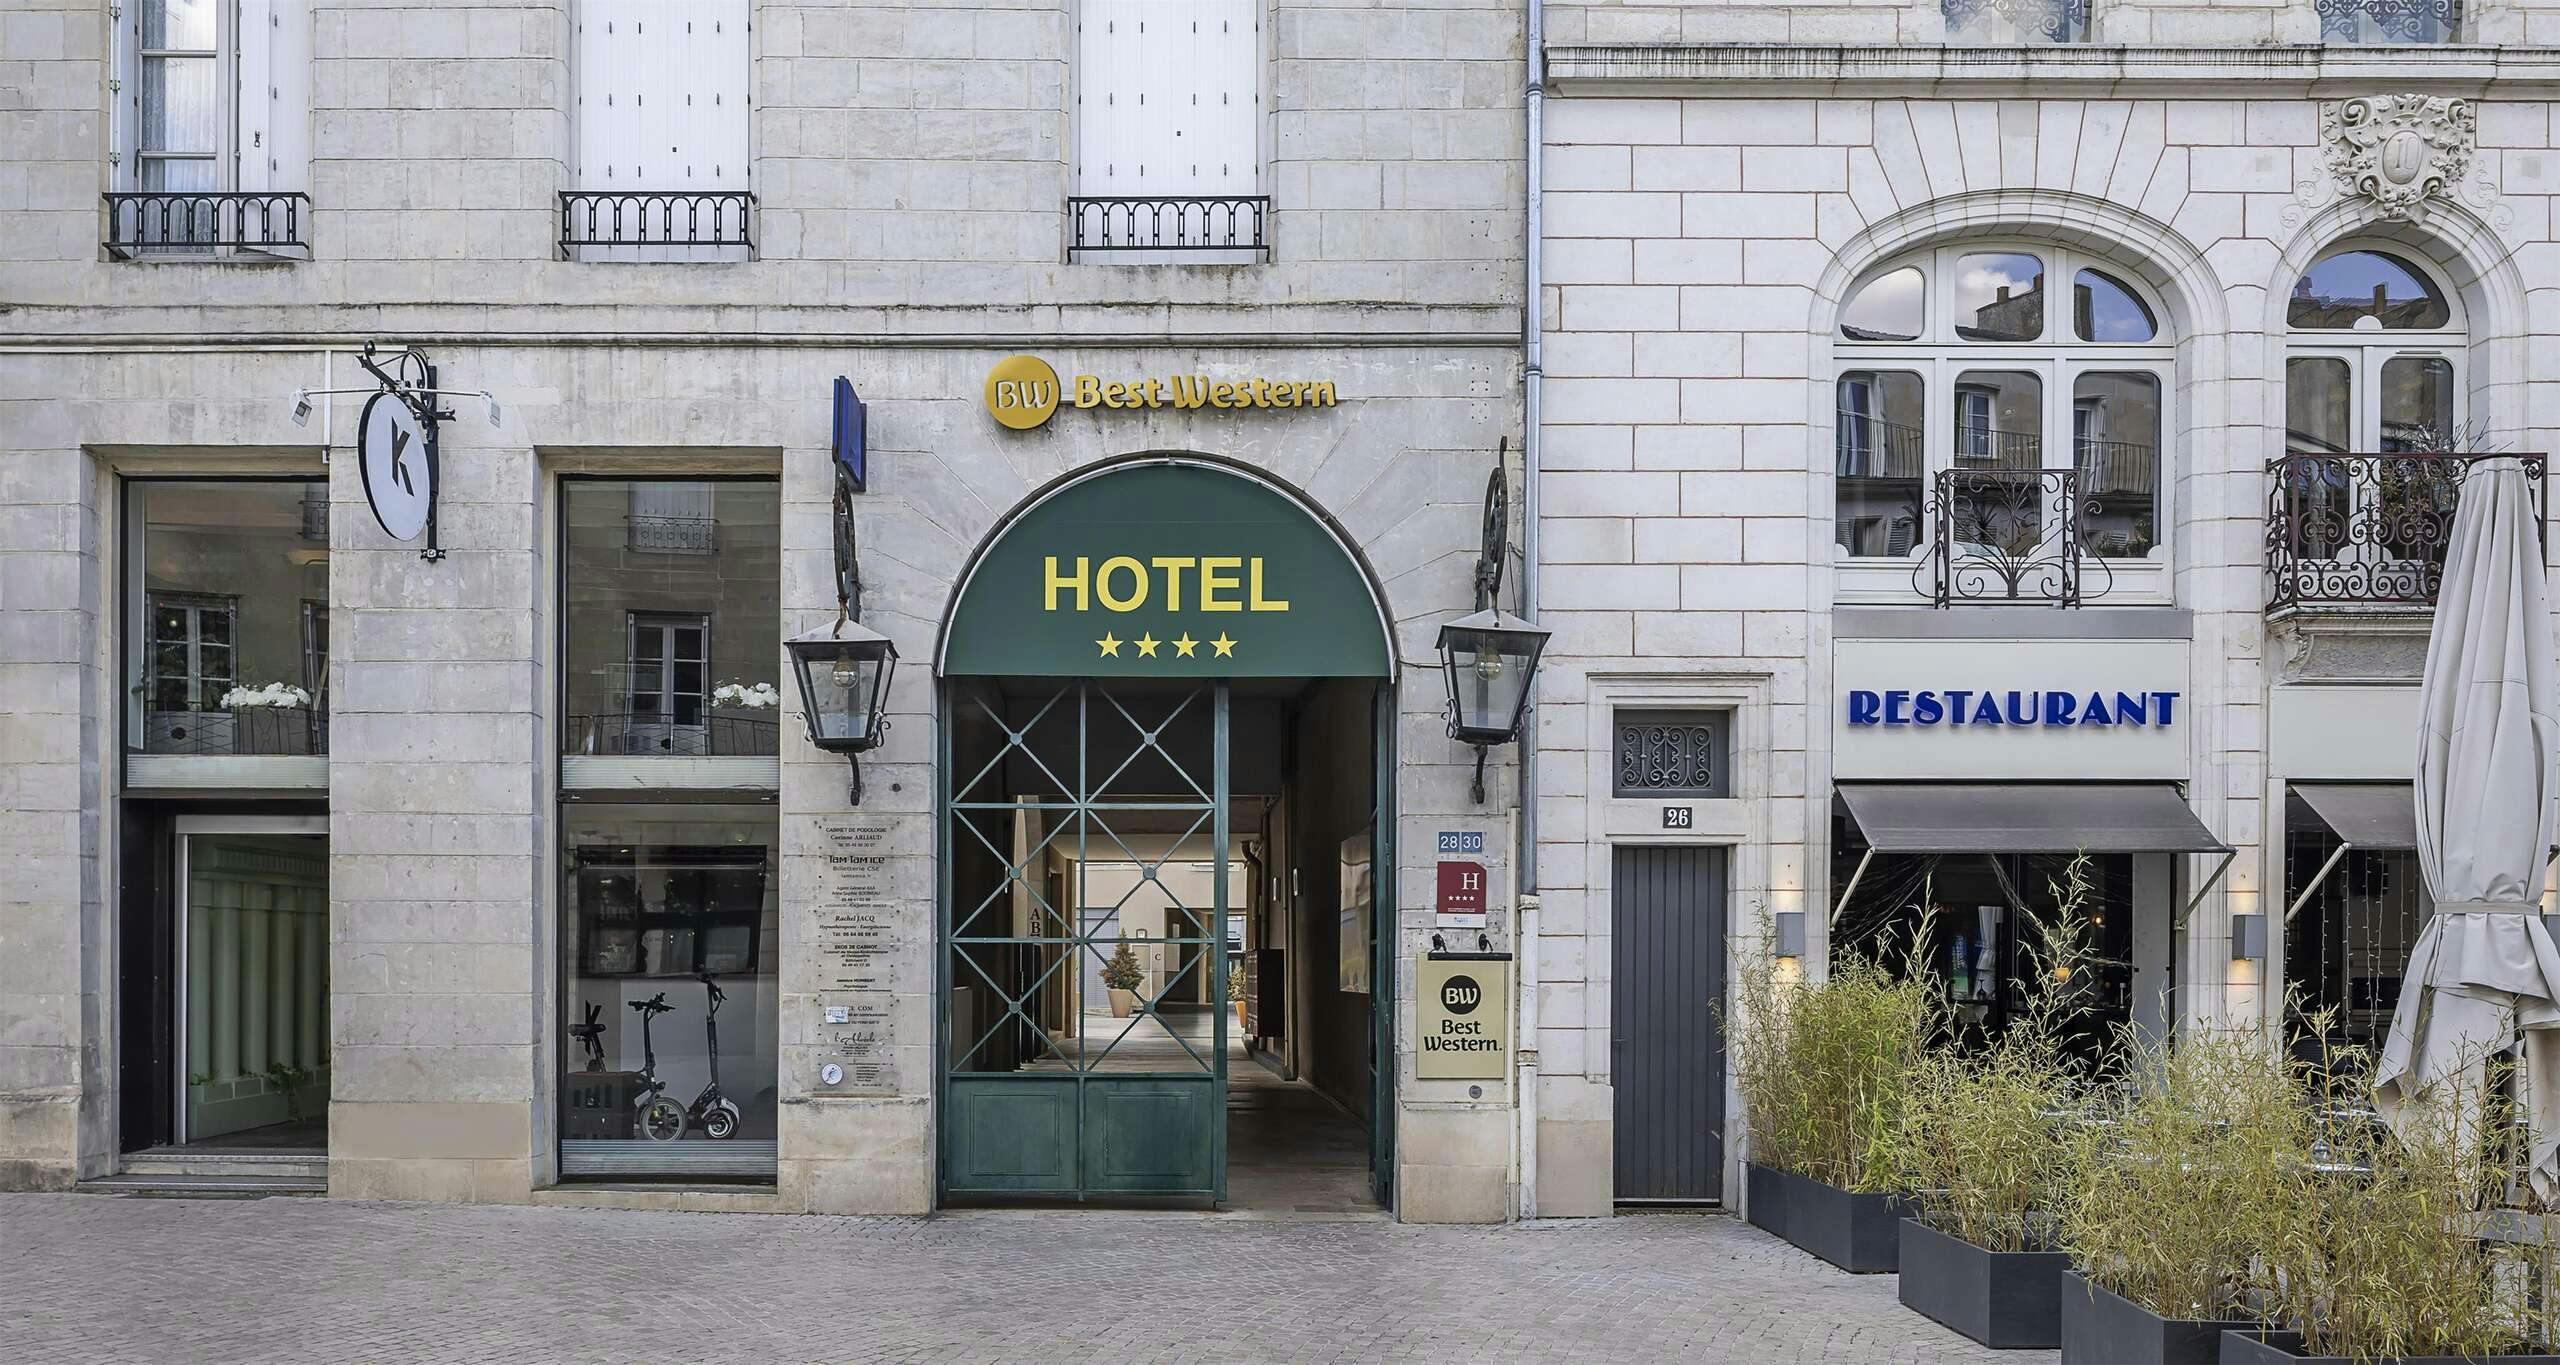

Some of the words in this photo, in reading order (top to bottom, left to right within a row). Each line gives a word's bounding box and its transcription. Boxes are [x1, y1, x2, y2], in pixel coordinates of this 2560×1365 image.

[995, 379, 1051, 410] BW
[1074, 374, 1163, 410] Best
[1170, 374, 1337, 410] Western
[391, 416, 415, 497] K
[1043, 556, 1290, 613] HOTEL
[1848, 690, 2181, 726] RESTAURANT
[1667, 808, 1689, 826] 26
[1440, 835, 1458, 849] 28
[1463, 835, 1481, 849] 30
[1461, 872, 1480, 890] H
[835, 914, 856, 922] Rachel
[856, 914, 876, 923] JACQ
[1030, 908, 1041, 921] A
[1031, 921, 1041, 934] B
[1445, 988, 1478, 1004] BW
[1441, 1019, 1482, 1035] Best
